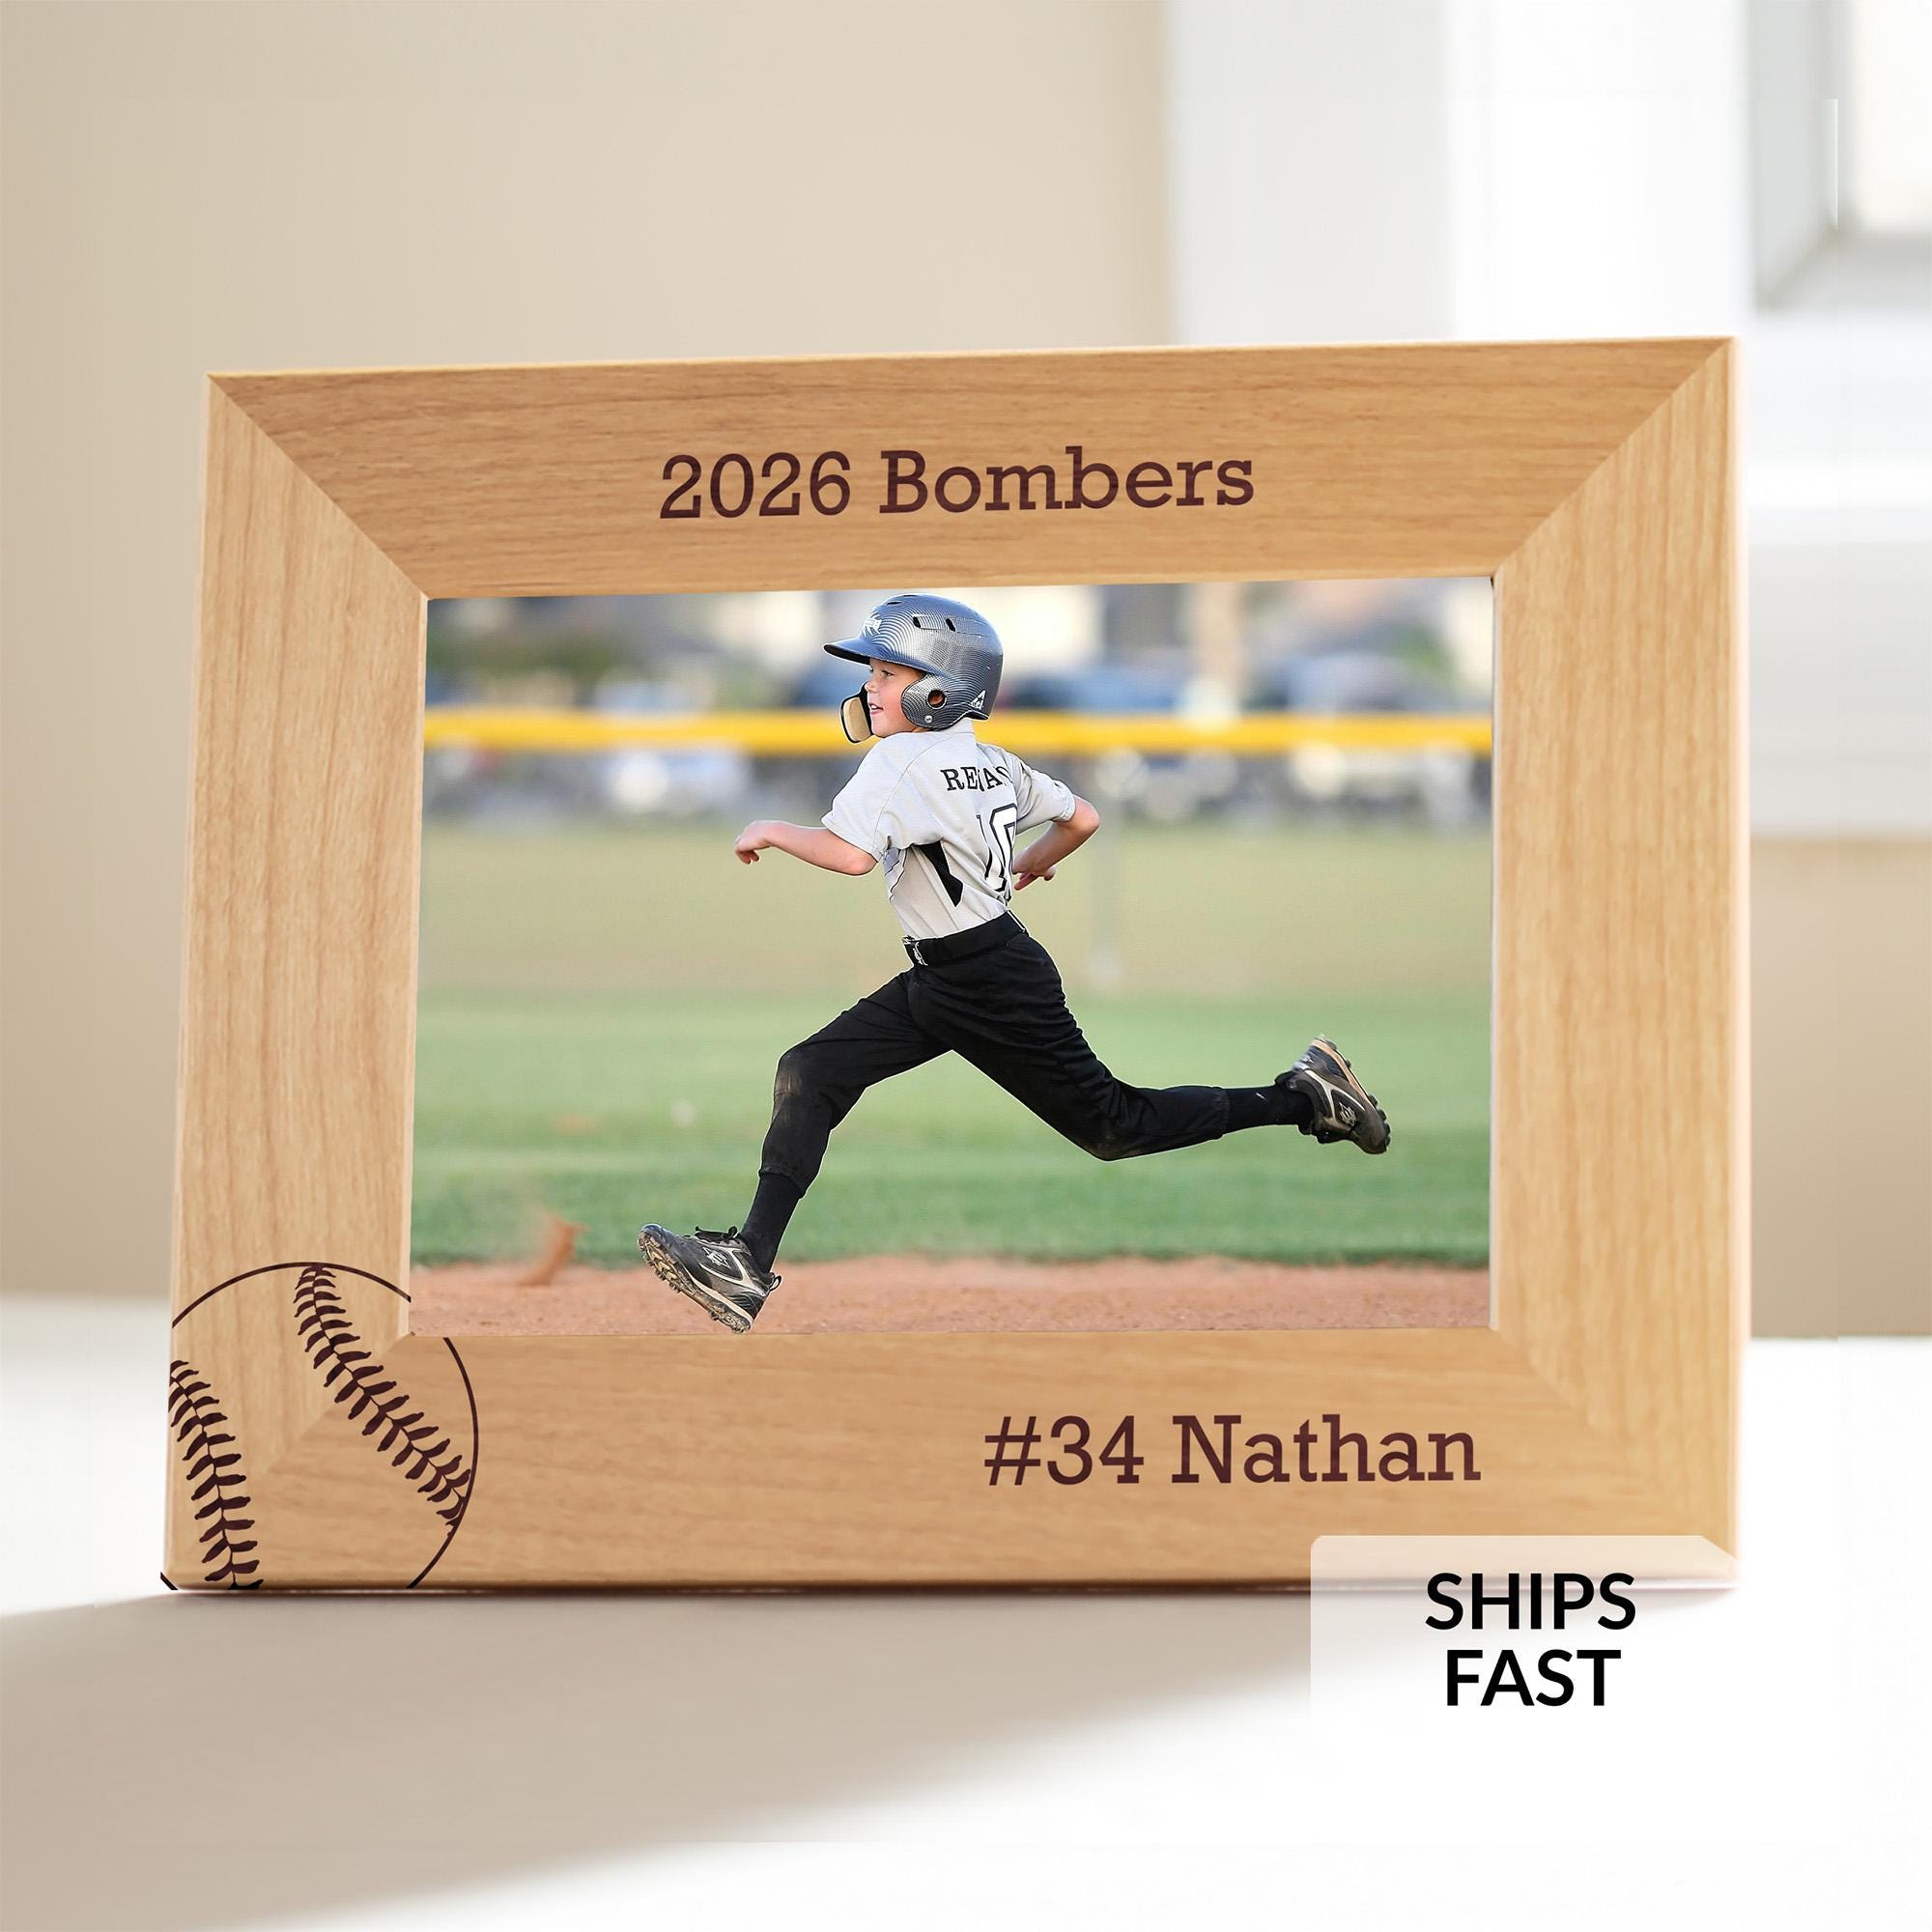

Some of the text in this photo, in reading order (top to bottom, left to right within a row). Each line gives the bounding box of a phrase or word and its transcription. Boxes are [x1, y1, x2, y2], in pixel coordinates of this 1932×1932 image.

[659, 445, 1255, 520] 2026 Bombers
[983, 1413, 1482, 1487] #34 Nathan
